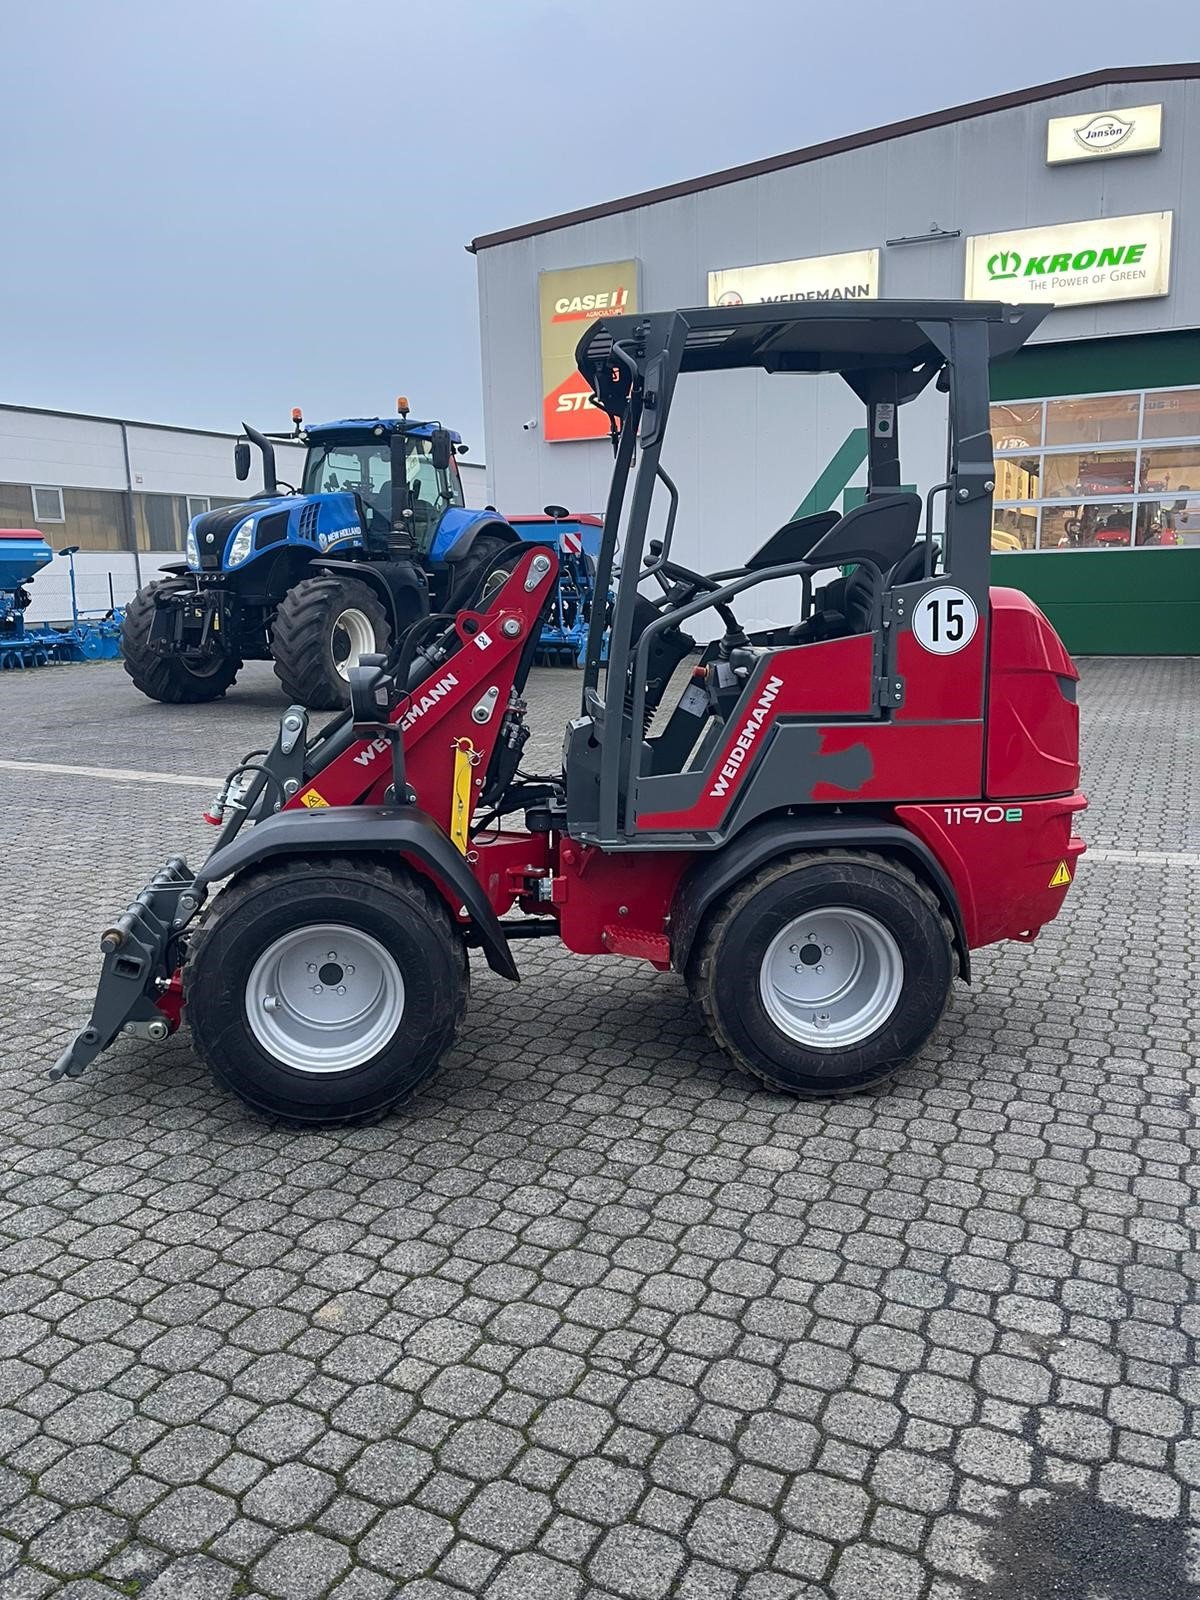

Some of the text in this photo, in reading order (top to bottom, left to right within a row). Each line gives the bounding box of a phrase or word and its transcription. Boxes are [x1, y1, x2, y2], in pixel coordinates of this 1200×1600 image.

[1085, 128, 1123, 140] Janson
[1023, 243, 1147, 276] KRONE
[555, 292, 610, 314] CASE
[339, 526, 362, 539] HOLLAND
[927, 599, 964, 642] 15
[353, 672, 459, 767] WEIEMANN
[709, 675, 785, 797] WEIDEMANN
[943, 806, 1023, 825] 1190e
